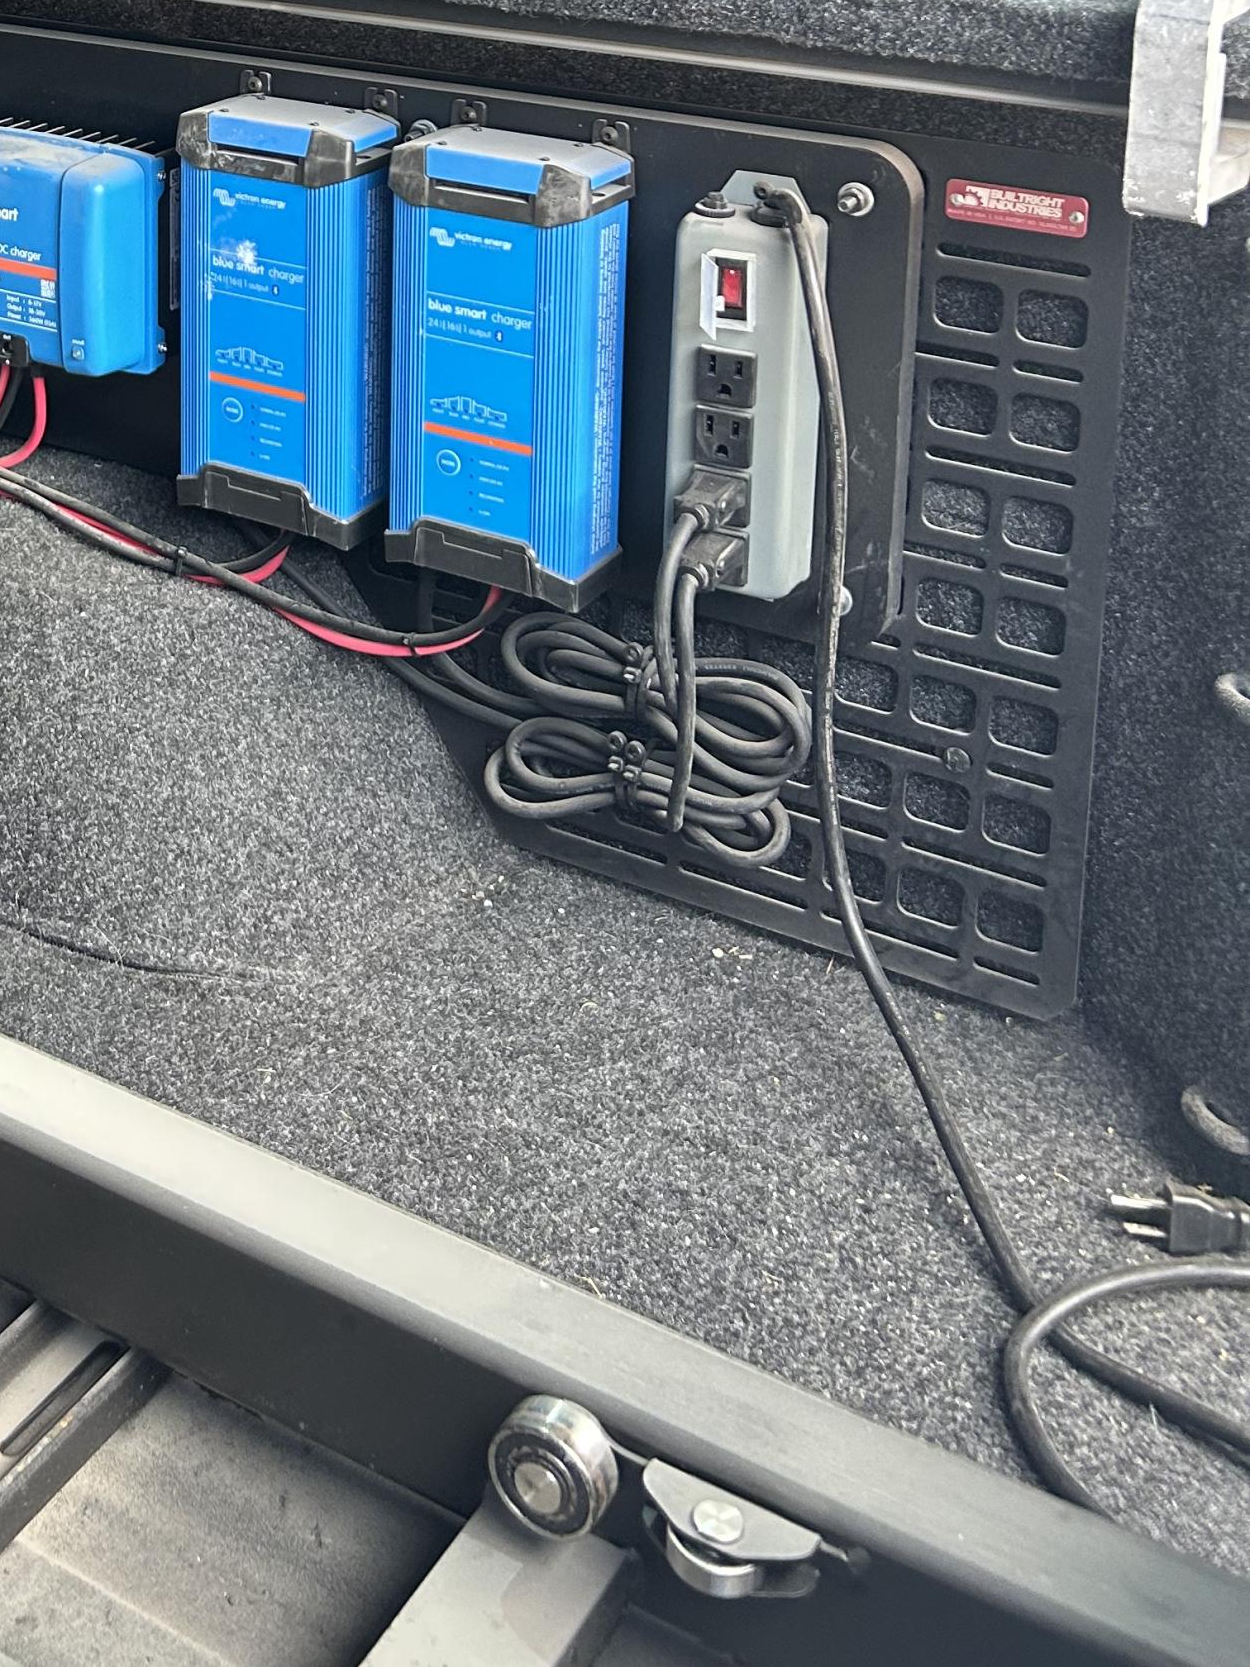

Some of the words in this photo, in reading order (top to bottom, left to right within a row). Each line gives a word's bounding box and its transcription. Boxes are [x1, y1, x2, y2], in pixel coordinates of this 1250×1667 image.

[235, 191, 260, 203] victron
[260, 197, 287, 210] energy
[990, 189, 1065, 208] BUILTRIGHT
[990, 199, 1063, 219] INDUSTRIES
[454, 231, 483, 243] victron
[483, 237, 513, 250] energy
[10, 246, 42, 262] charger
[212, 255, 234, 269] blue
[236, 261, 264, 275] smart
[268, 267, 304, 284] charger
[428, 298, 452, 313] blue
[454, 305, 487, 320] smart
[491, 311, 532, 330] charger
